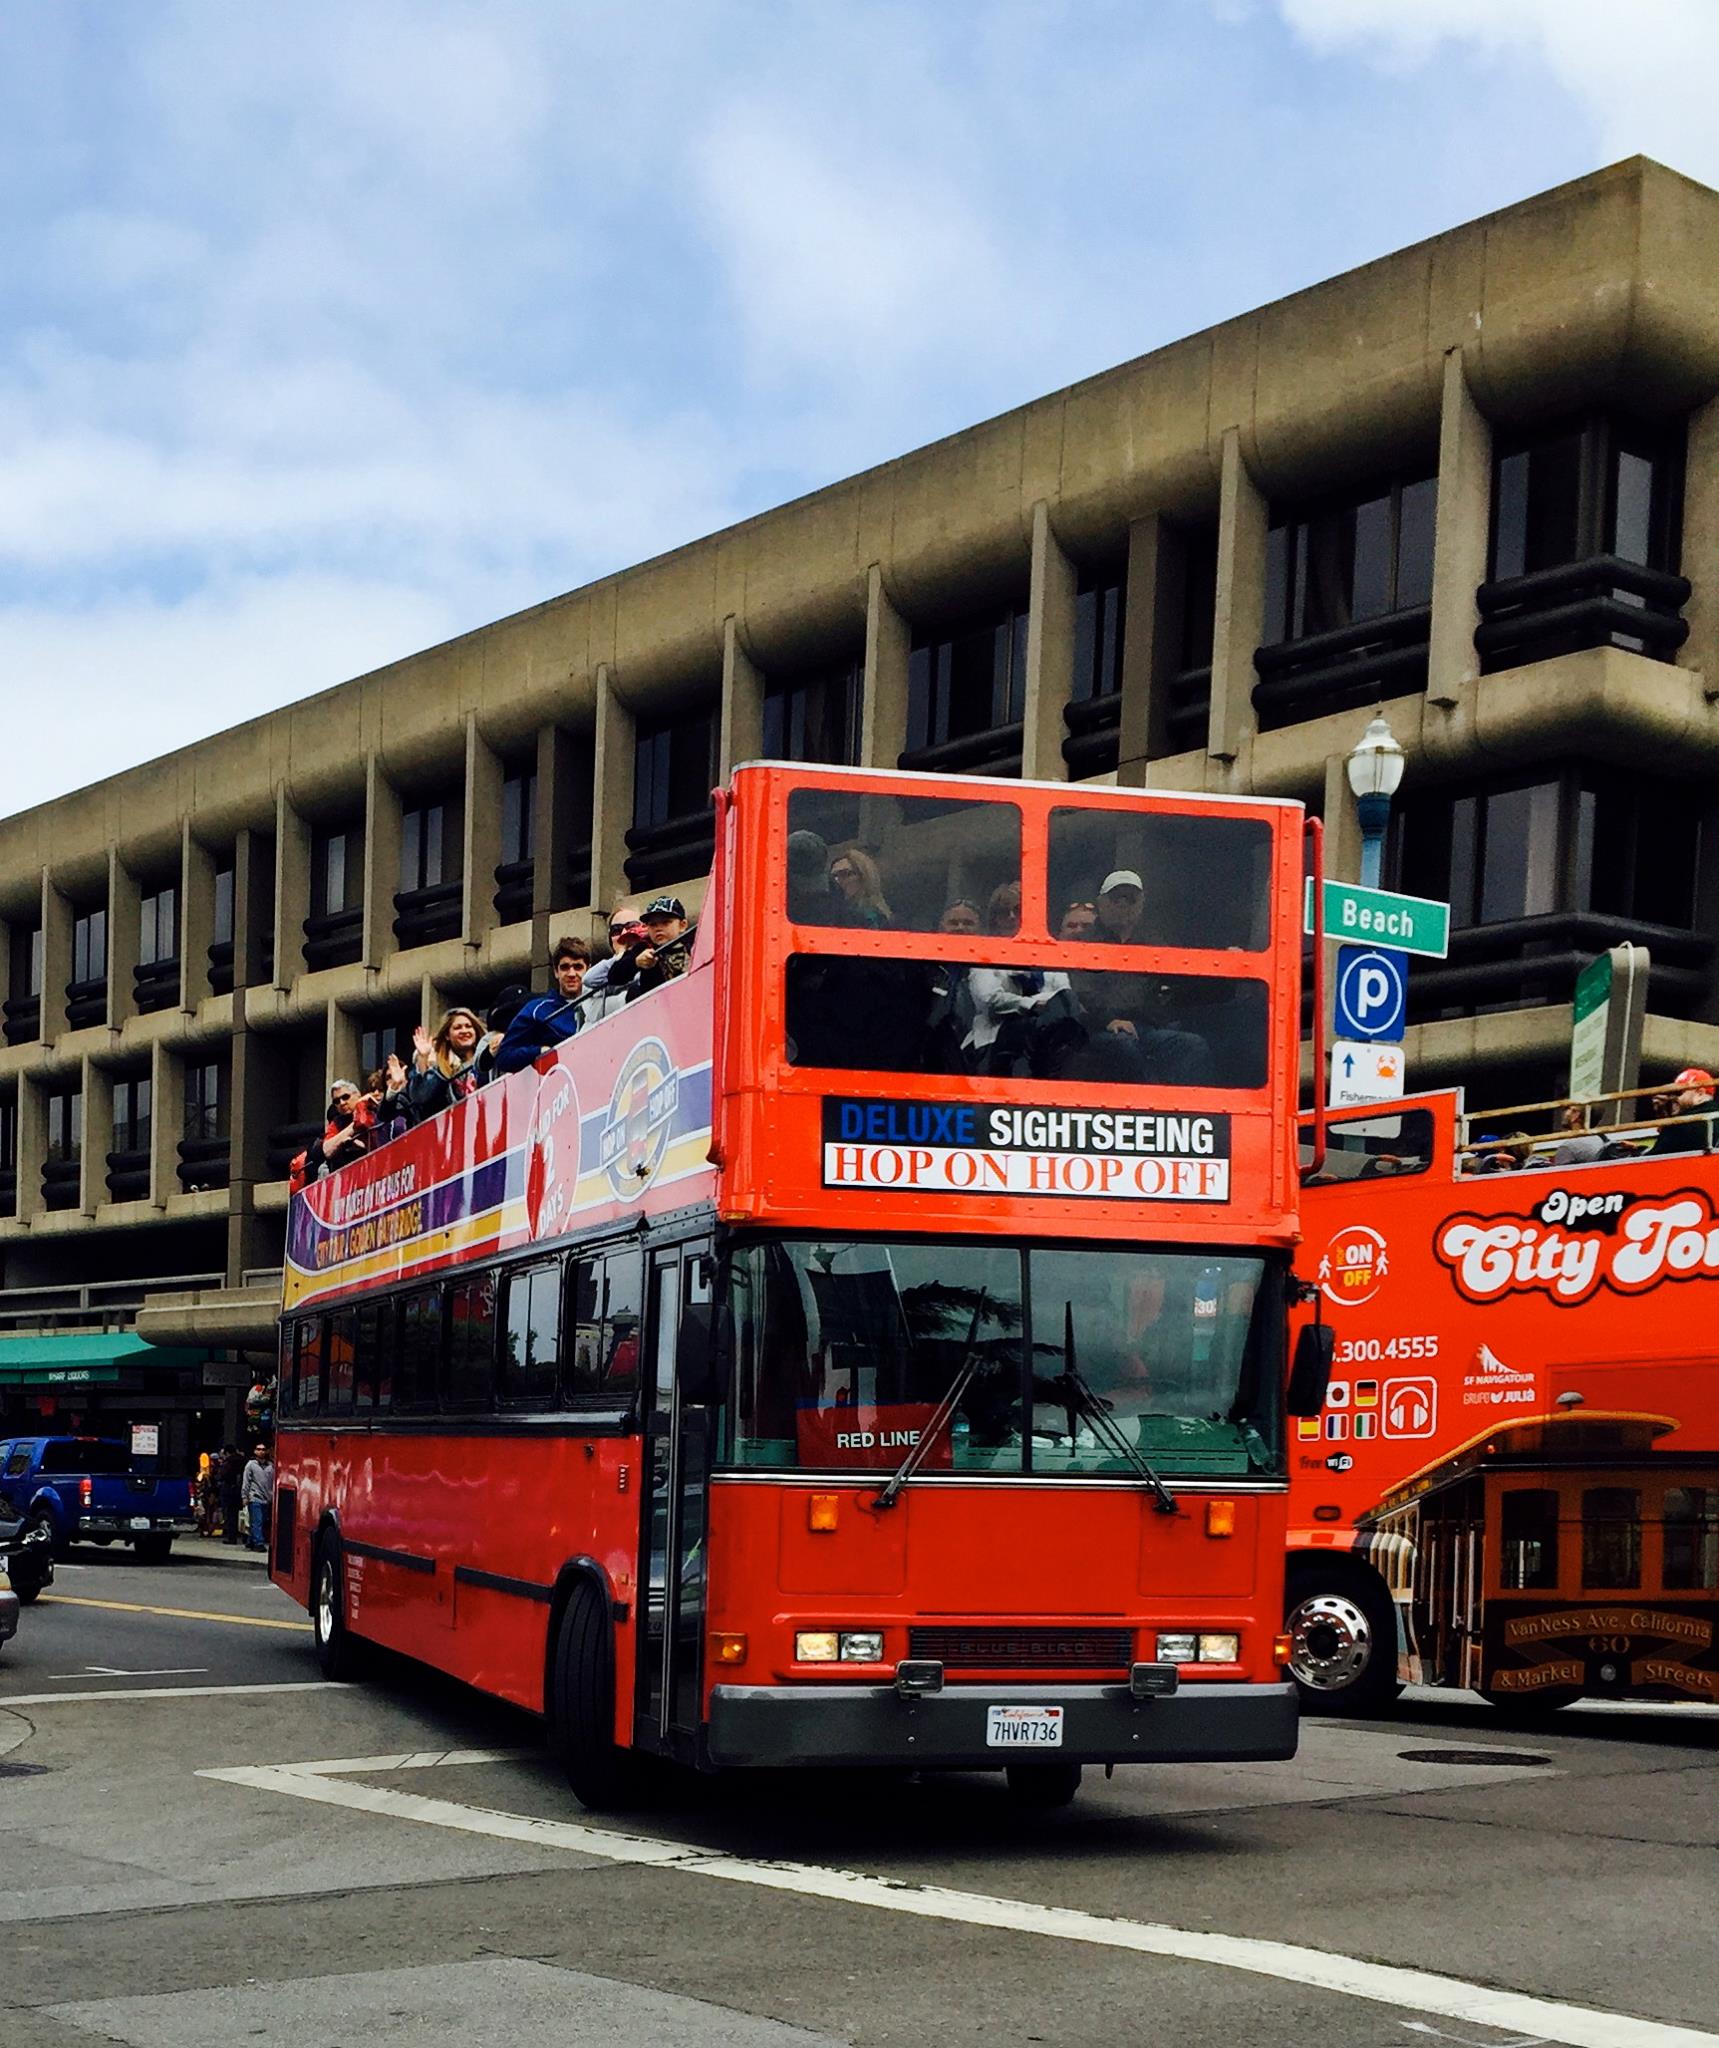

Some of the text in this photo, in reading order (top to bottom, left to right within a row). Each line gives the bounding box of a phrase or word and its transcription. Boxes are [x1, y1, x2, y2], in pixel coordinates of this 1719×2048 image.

[1342, 899, 1413, 938] Beach
[840, 1103, 1214, 1154] DELUXE SIGHTSEEING
[832, 1146, 1222, 1196] HOP ON HOP OFF
[539, 1183, 564, 1234] DAYS
[1541, 1191, 1624, 1225] Open
[1345, 1243, 1373, 1265] ON
[1443, 1224, 1601, 1296] City
[1343, 1269, 1372, 1287] OFF
[1332, 1335, 1439, 1362] .300.4555
[836, 1430, 920, 1449] RED LINE
[1510, 1621, 1538, 1637] Van
[1541, 1616, 1580, 1633] Ness
[1630, 1612, 1711, 1639] California
[1588, 1635, 1631, 1654] 60
[1501, 1662, 1713, 1688] & Market Streets
[993, 1721, 1059, 1741] 7HVR736
